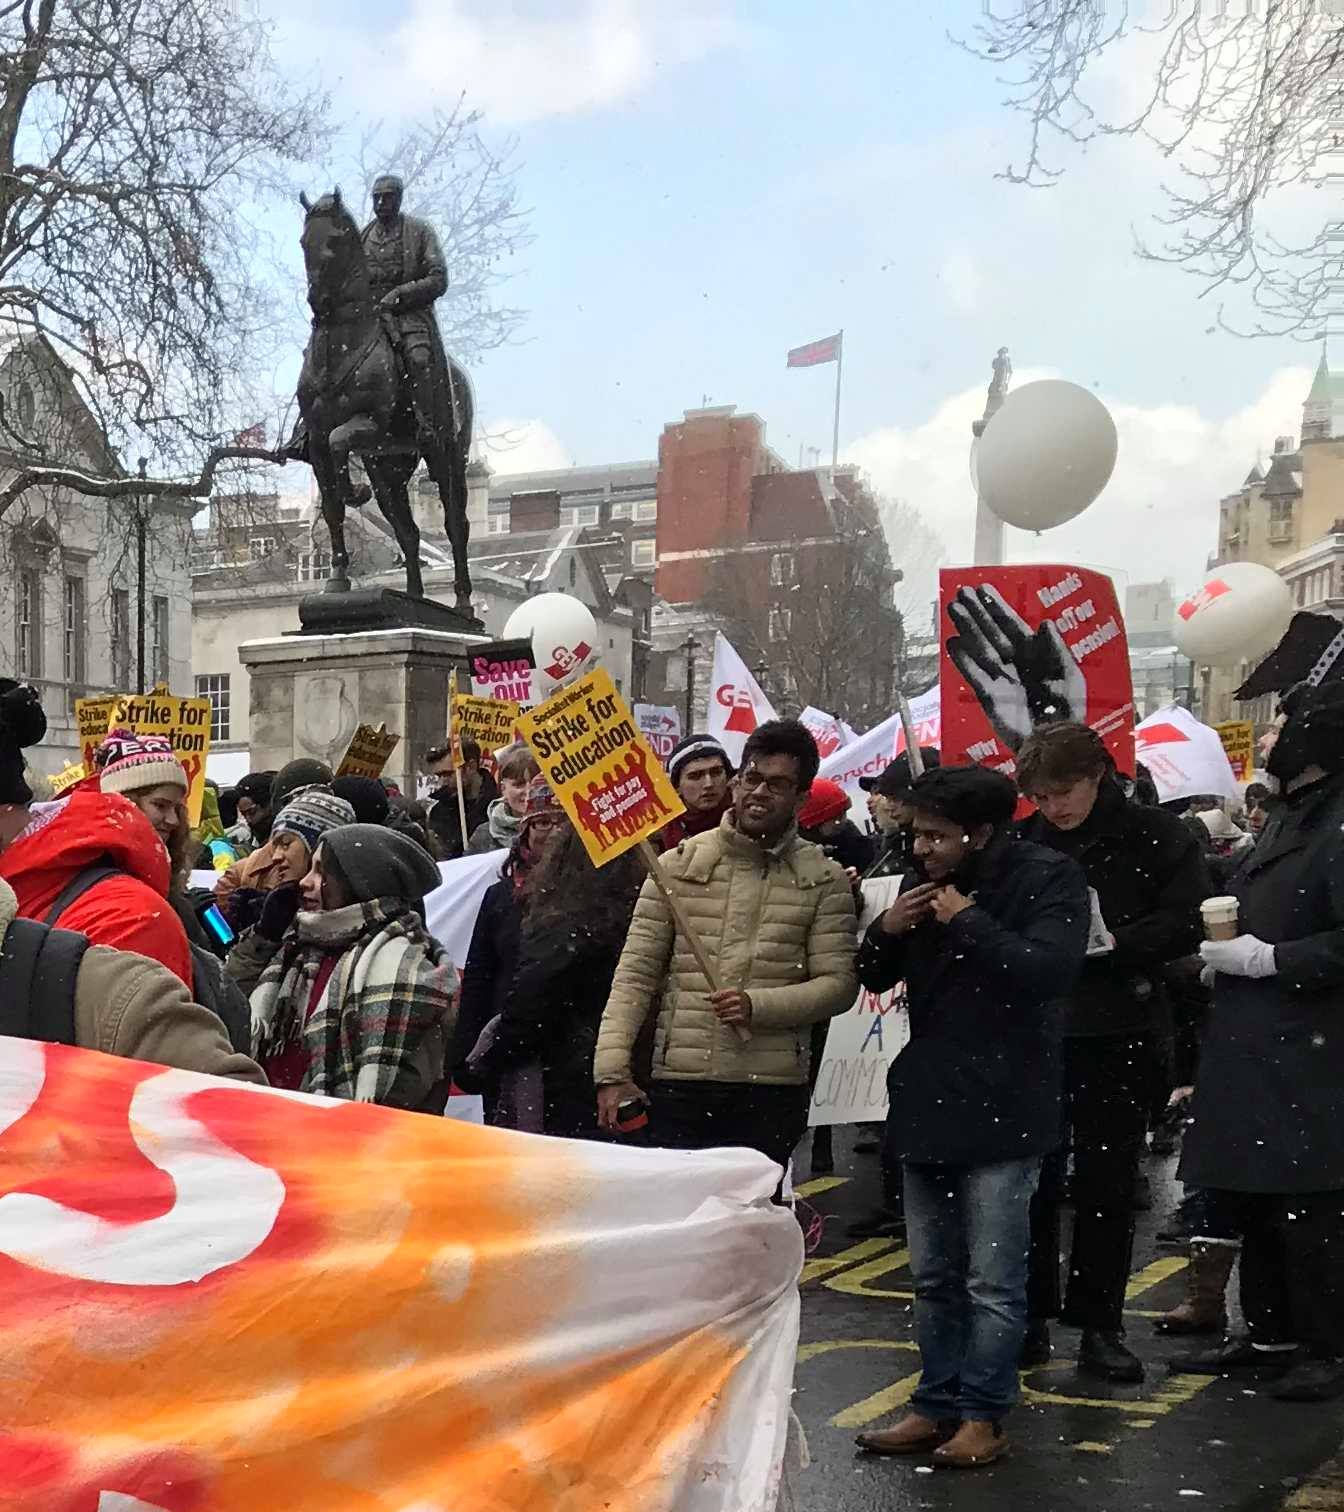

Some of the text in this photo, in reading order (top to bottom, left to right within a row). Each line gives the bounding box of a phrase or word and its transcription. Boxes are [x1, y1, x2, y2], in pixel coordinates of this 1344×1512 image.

[473, 656, 531, 685] Save
[115, 700, 207, 726] Strike for
[457, 705, 492, 725] Strike
[495, 711, 515, 727] for
[531, 714, 590, 759] Strike
[585, 694, 618, 725] for
[460, 723, 511, 744] ducation
[550, 719, 636, 785] education
